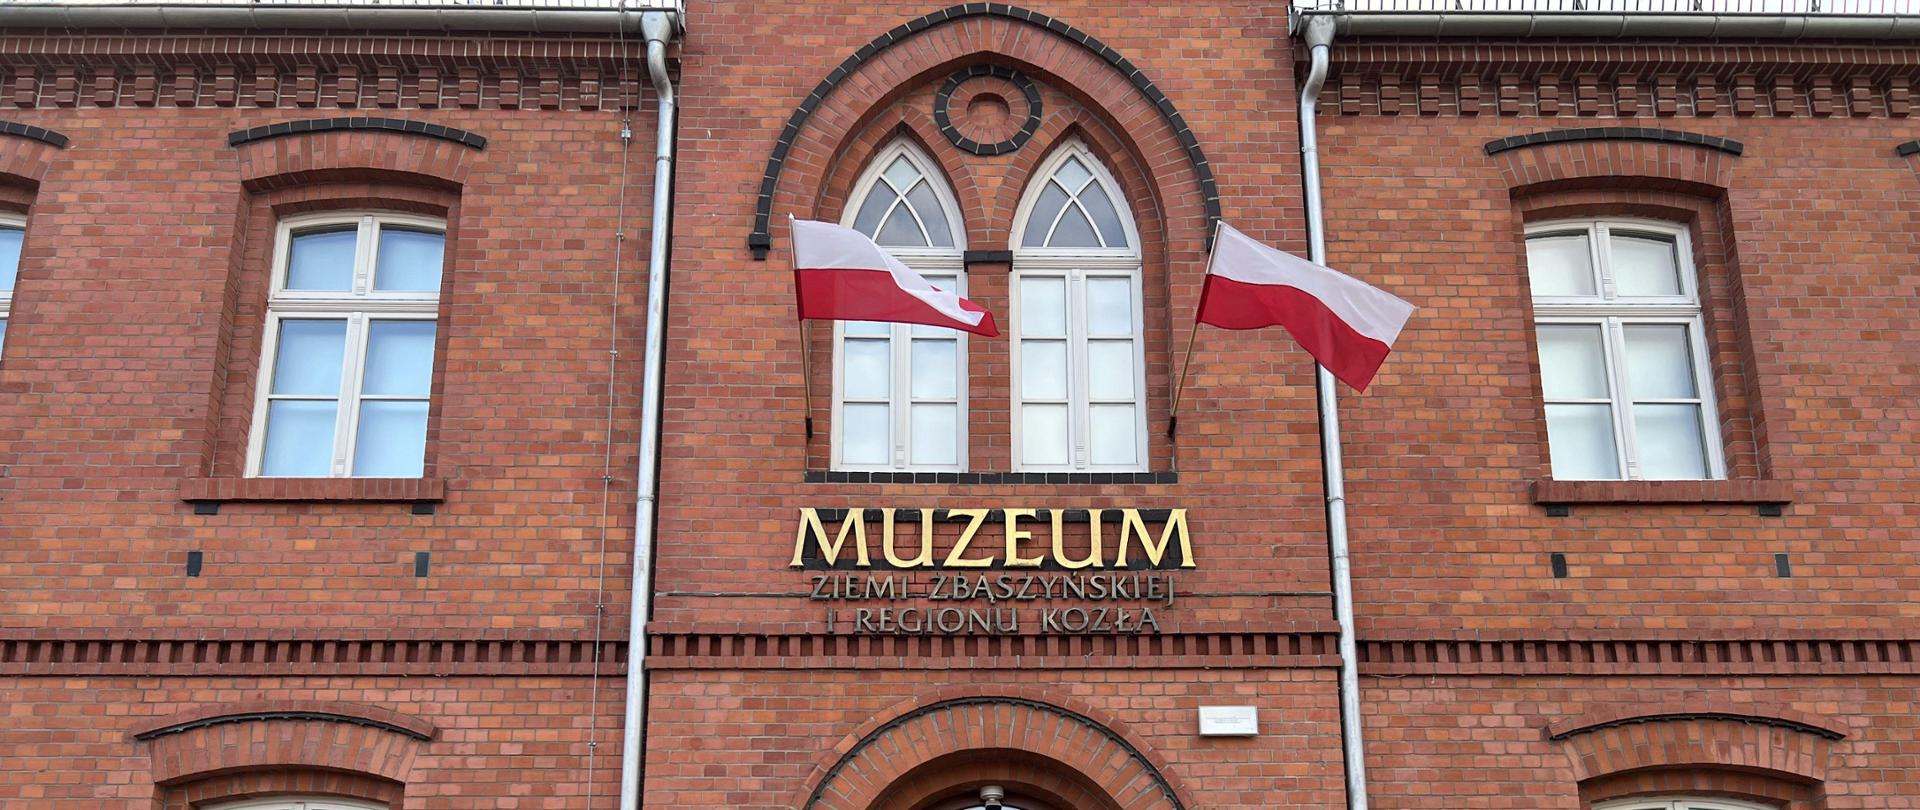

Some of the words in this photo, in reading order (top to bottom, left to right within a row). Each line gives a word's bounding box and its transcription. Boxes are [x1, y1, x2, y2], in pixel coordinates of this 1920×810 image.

[788, 507, 1197, 569] MUZEUM
[810, 574, 908, 601] ZIEMI
[928, 571, 1176, 606] ZBĄSZYŃSKIEJ
[826, 607, 836, 633] I
[854, 607, 1019, 634] REGIONU
[1041, 607, 1160, 633] KOZŁA
